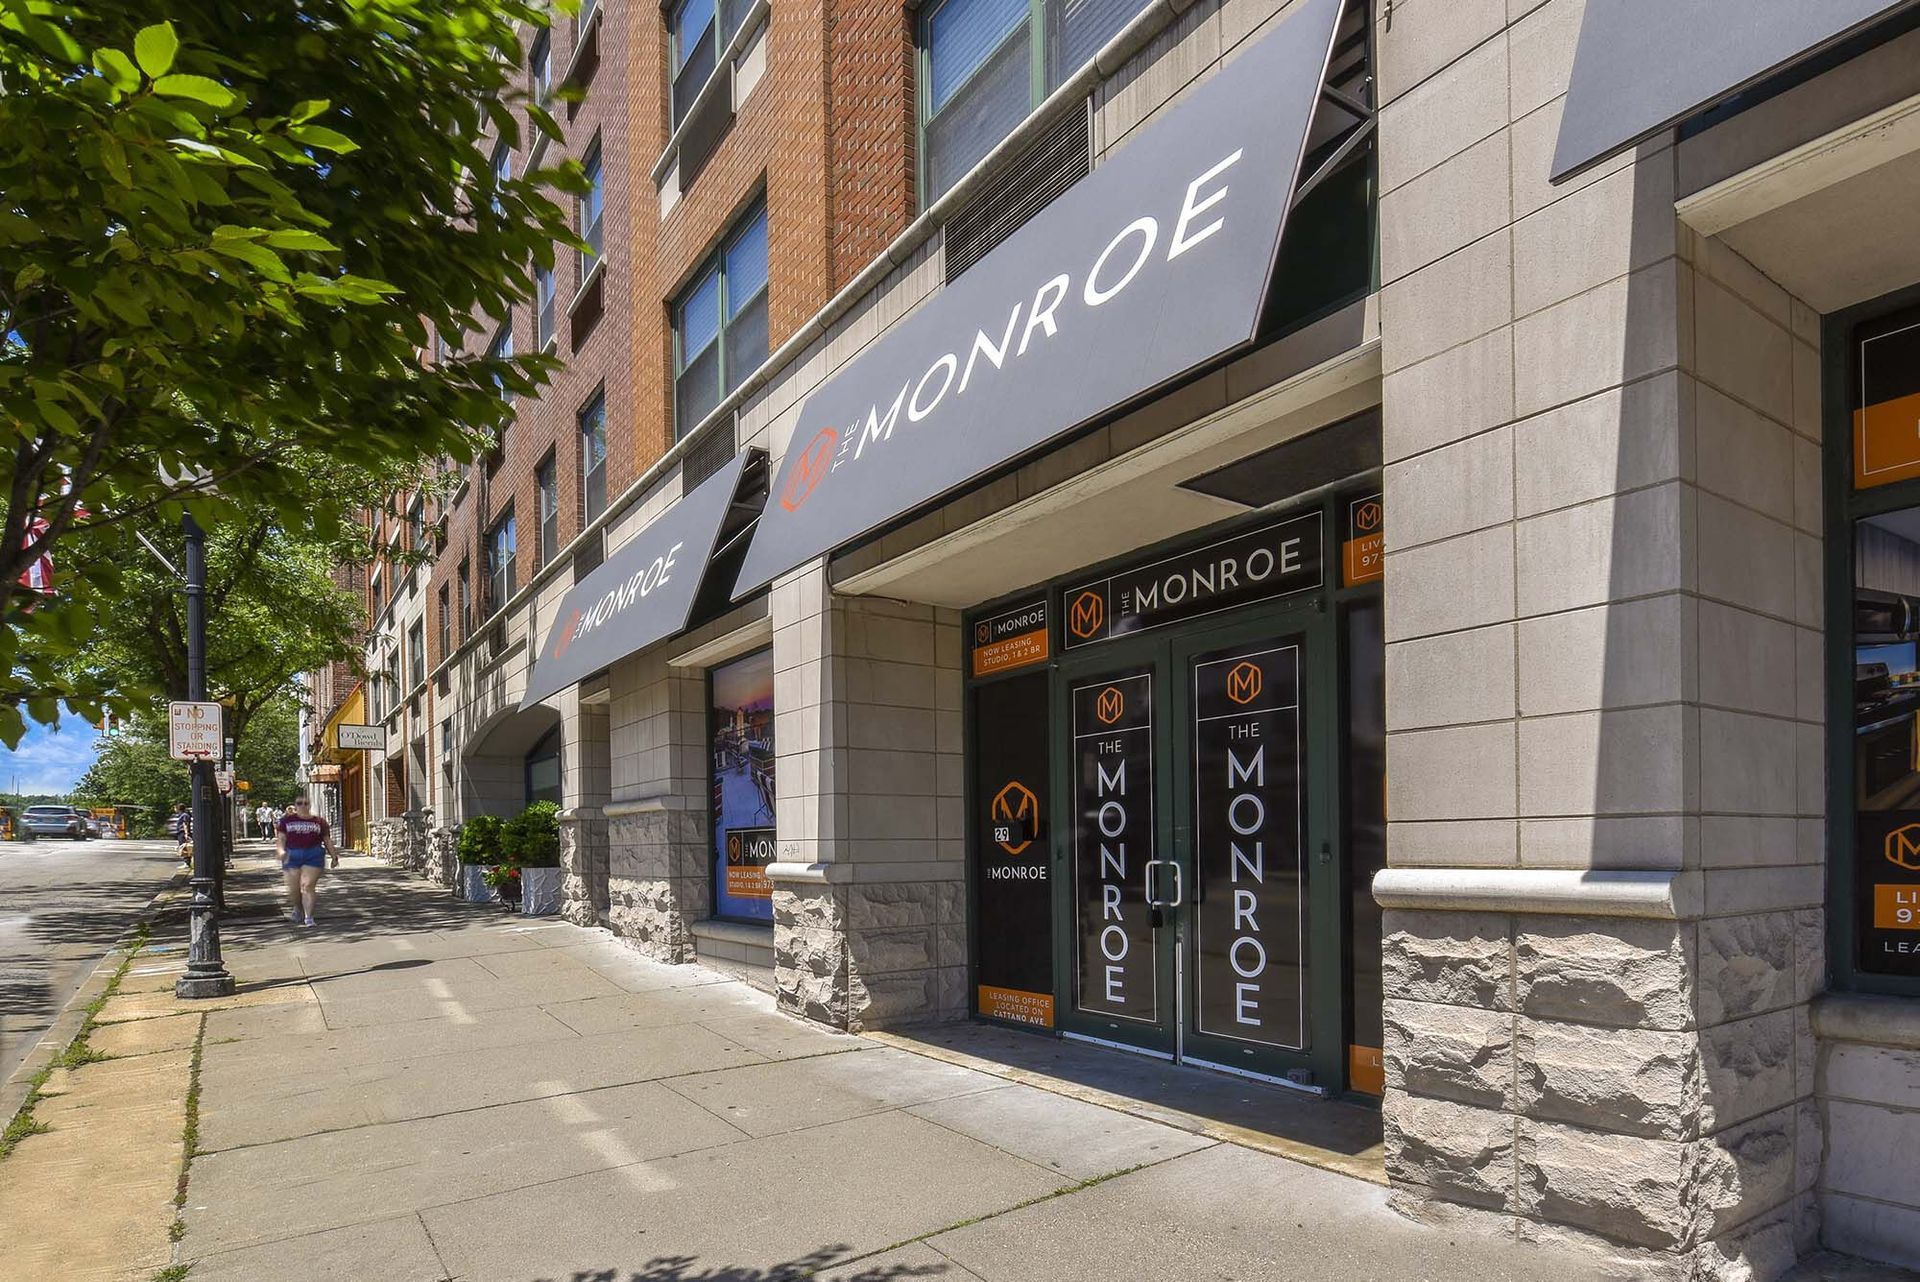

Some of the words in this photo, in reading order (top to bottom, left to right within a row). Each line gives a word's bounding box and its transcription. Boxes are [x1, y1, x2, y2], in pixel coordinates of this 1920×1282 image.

[831, 419, 860, 473] THE
[853, 146, 1244, 461] MONROE
[1121, 591, 1130, 617] THE
[1135, 537, 1302, 614] MONROE
[577, 541, 684, 639] MONROE
[998, 609, 1045, 635] MONROE
[983, 648, 1000, 658] NOW
[1001, 637, 1032, 653] LEASING
[983, 654, 1012, 667] STUDIO,
[1030, 644, 1041, 654] BR
[187, 708, 205, 720] NO
[174, 722, 218, 732] STOPPING
[1228, 722, 1260, 740] THE
[190, 732, 204, 741] OR
[176, 742, 218, 750] STANDING
[1098, 740, 1122, 755] THE
[995, 829, 1008, 841] 29
[991, 866, 1047, 880] MONROE
[1098, 758, 1129, 1003] MONROE
[1228, 744, 1267, 1026] MONROE
[989, 991, 1020, 1003] LEASING
[1022, 996, 1050, 1008] OFFICE
[996, 1001, 1030, 1013] LOCATED
[1032, 1007, 1043, 1016] ON
[993, 1009, 1027, 1022] CATTANO
[1029, 1016, 1047, 1027] AVE.
